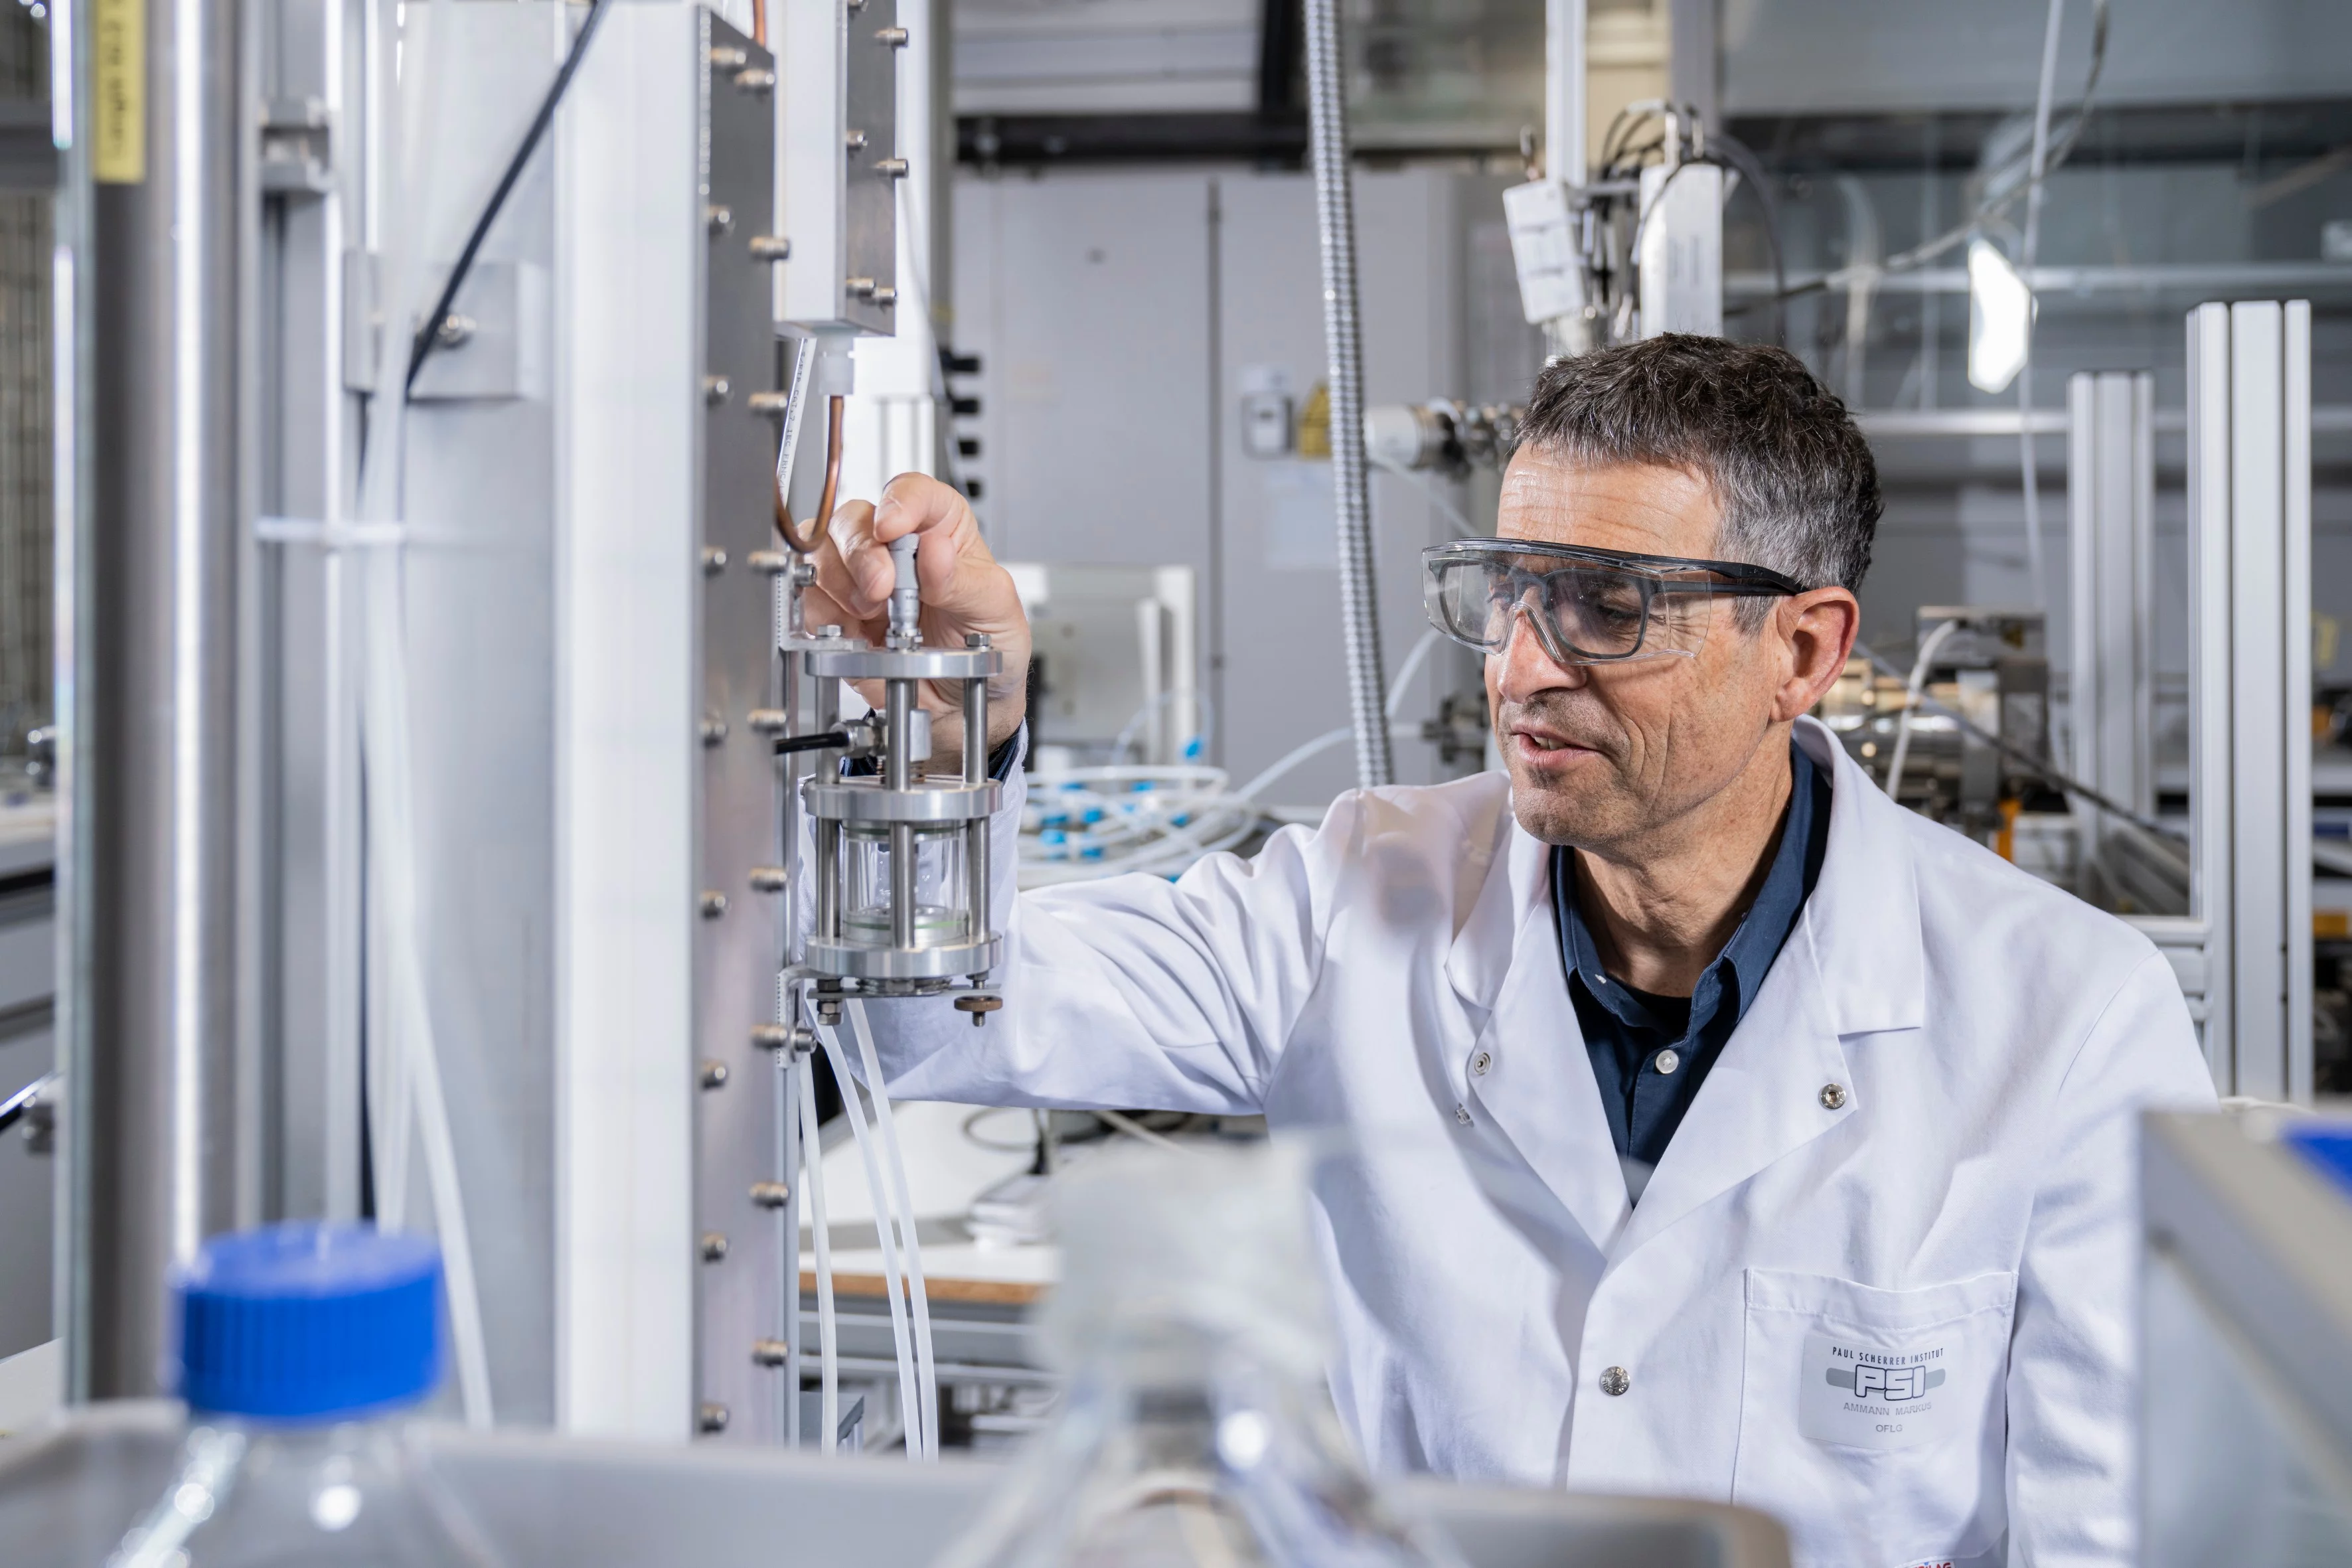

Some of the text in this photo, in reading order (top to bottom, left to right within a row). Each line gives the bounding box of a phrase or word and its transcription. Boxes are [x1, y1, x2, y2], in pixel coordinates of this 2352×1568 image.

[1832, 1346, 1944, 1365] PAUL SCHERRER INSTITUT
[1854, 1364, 1926, 1401] PSI
[1843, 1402, 1932, 1415] AMMANN MARKUS
[1875, 1424, 1903, 1433] OFLG
